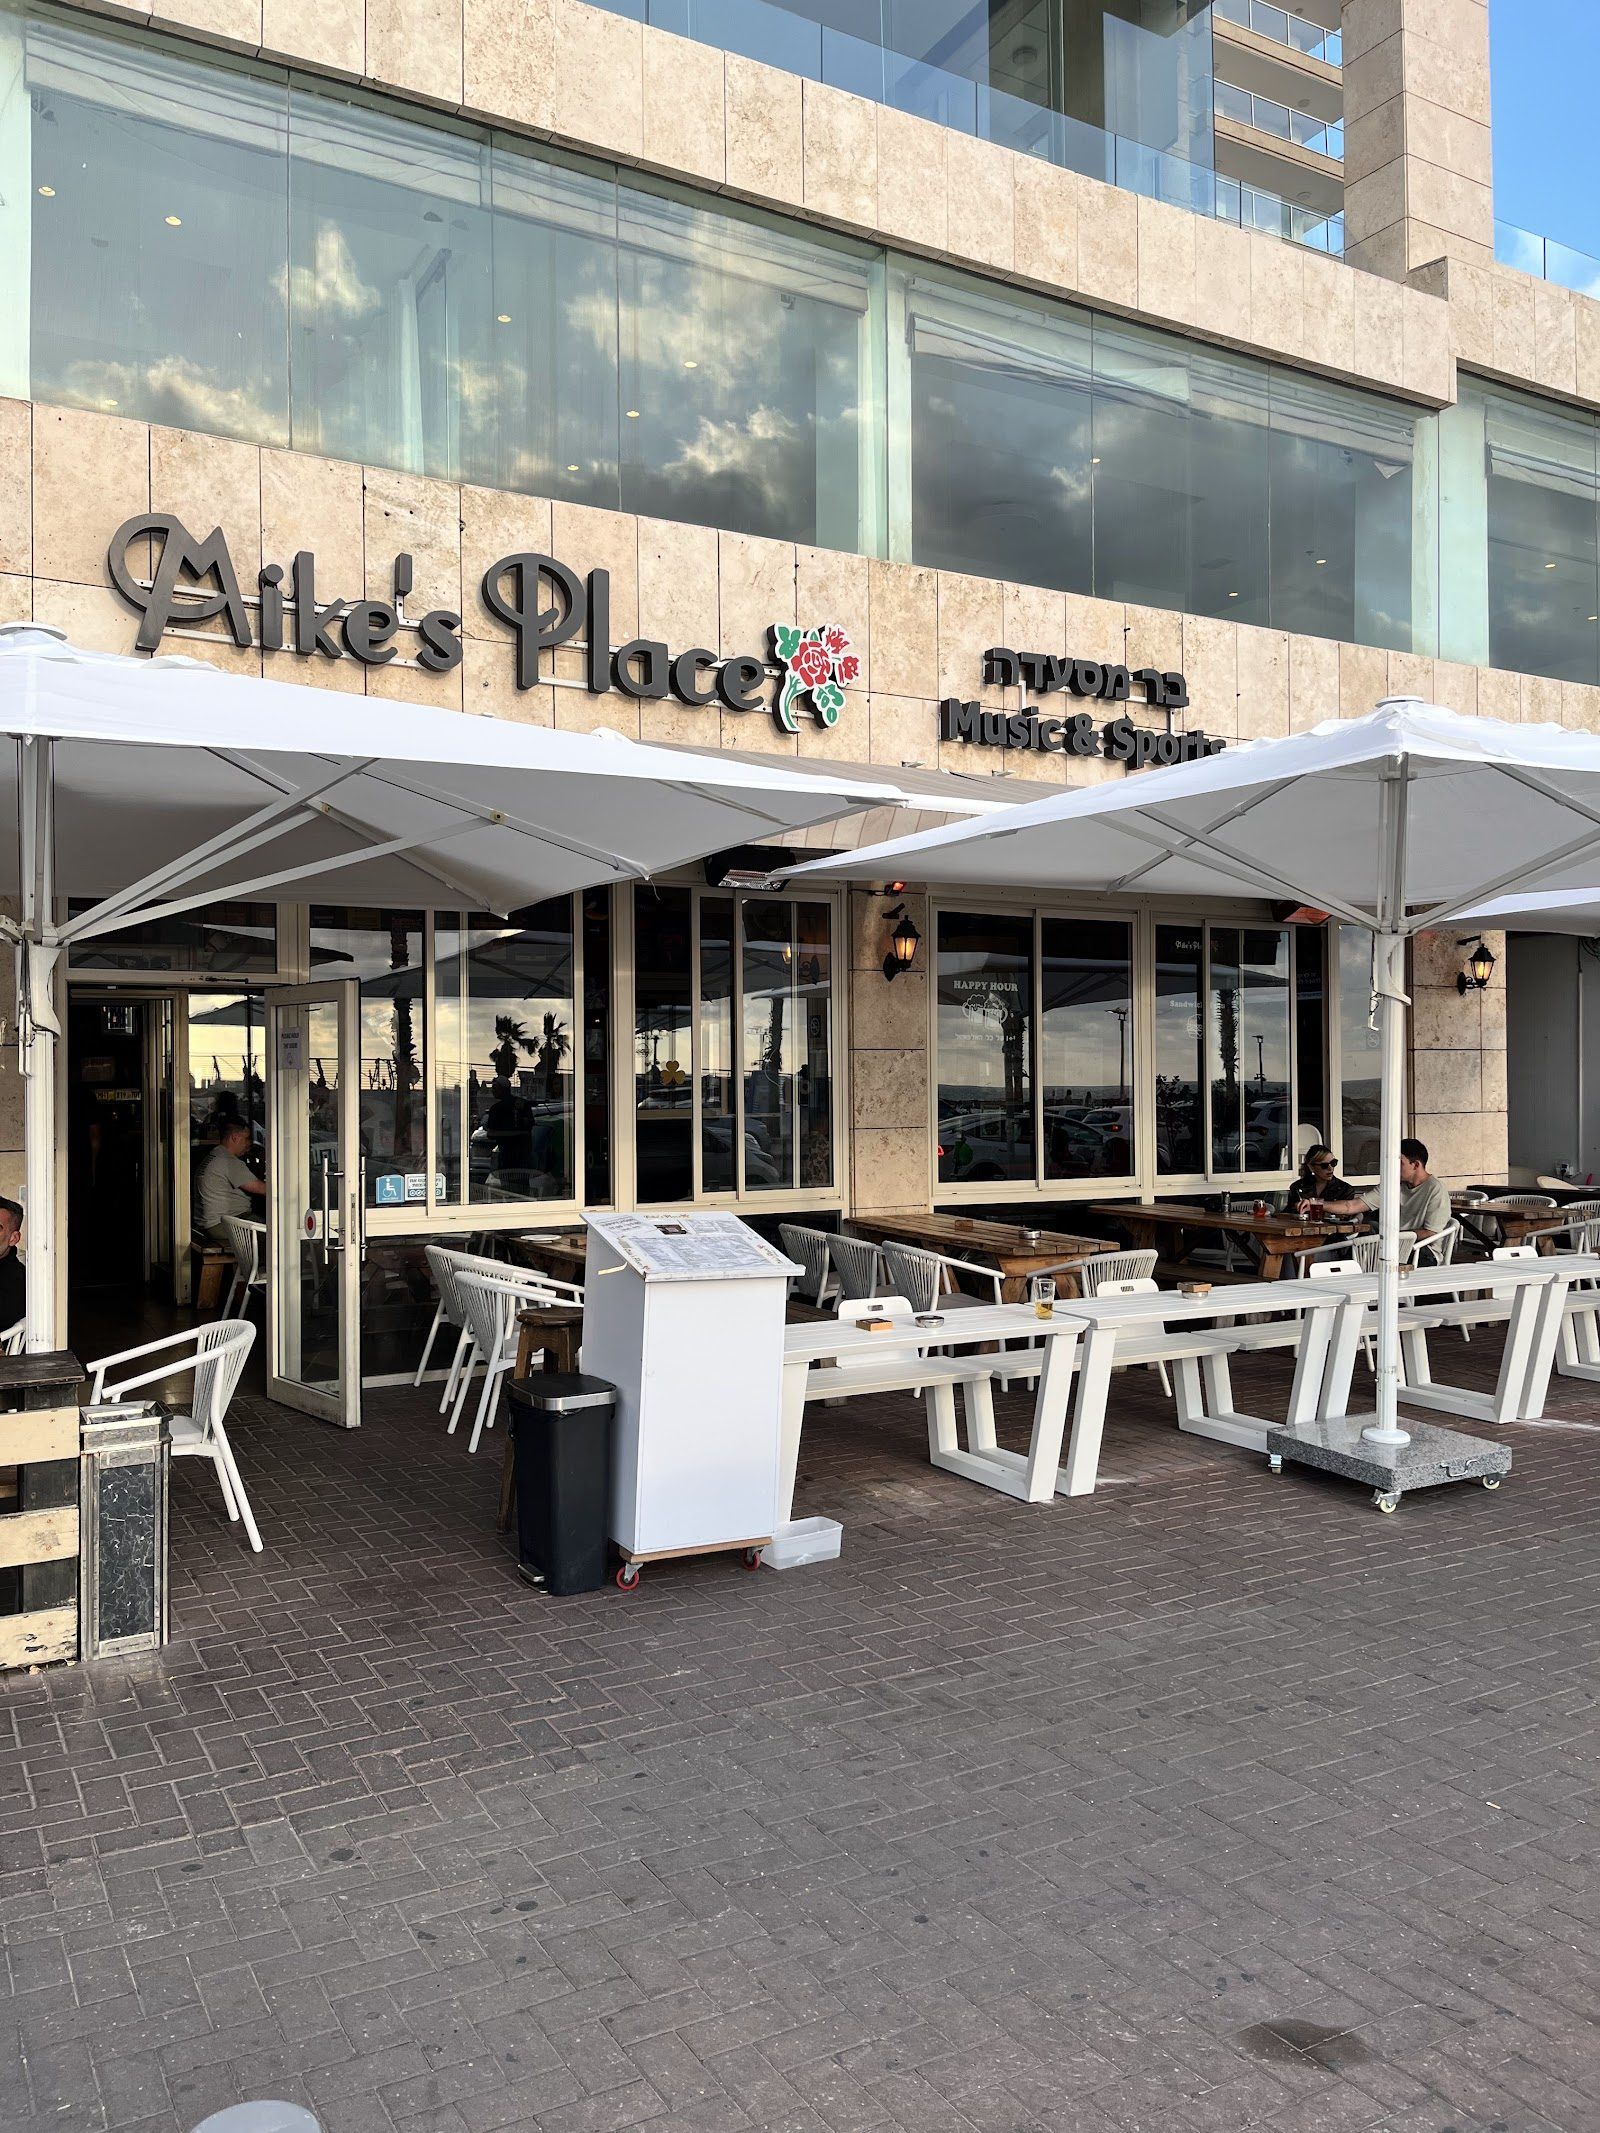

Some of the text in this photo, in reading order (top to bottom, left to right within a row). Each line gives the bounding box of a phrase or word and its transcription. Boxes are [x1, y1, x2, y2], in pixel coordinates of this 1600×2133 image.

[109, 513, 765, 712] Mike's Place
[983, 647, 1189, 707] בר מסעדה
[940, 698, 1062, 751] Music
[1064, 712, 1100, 757] &
[953, 980, 1018, 991] HAPPY HOUR
